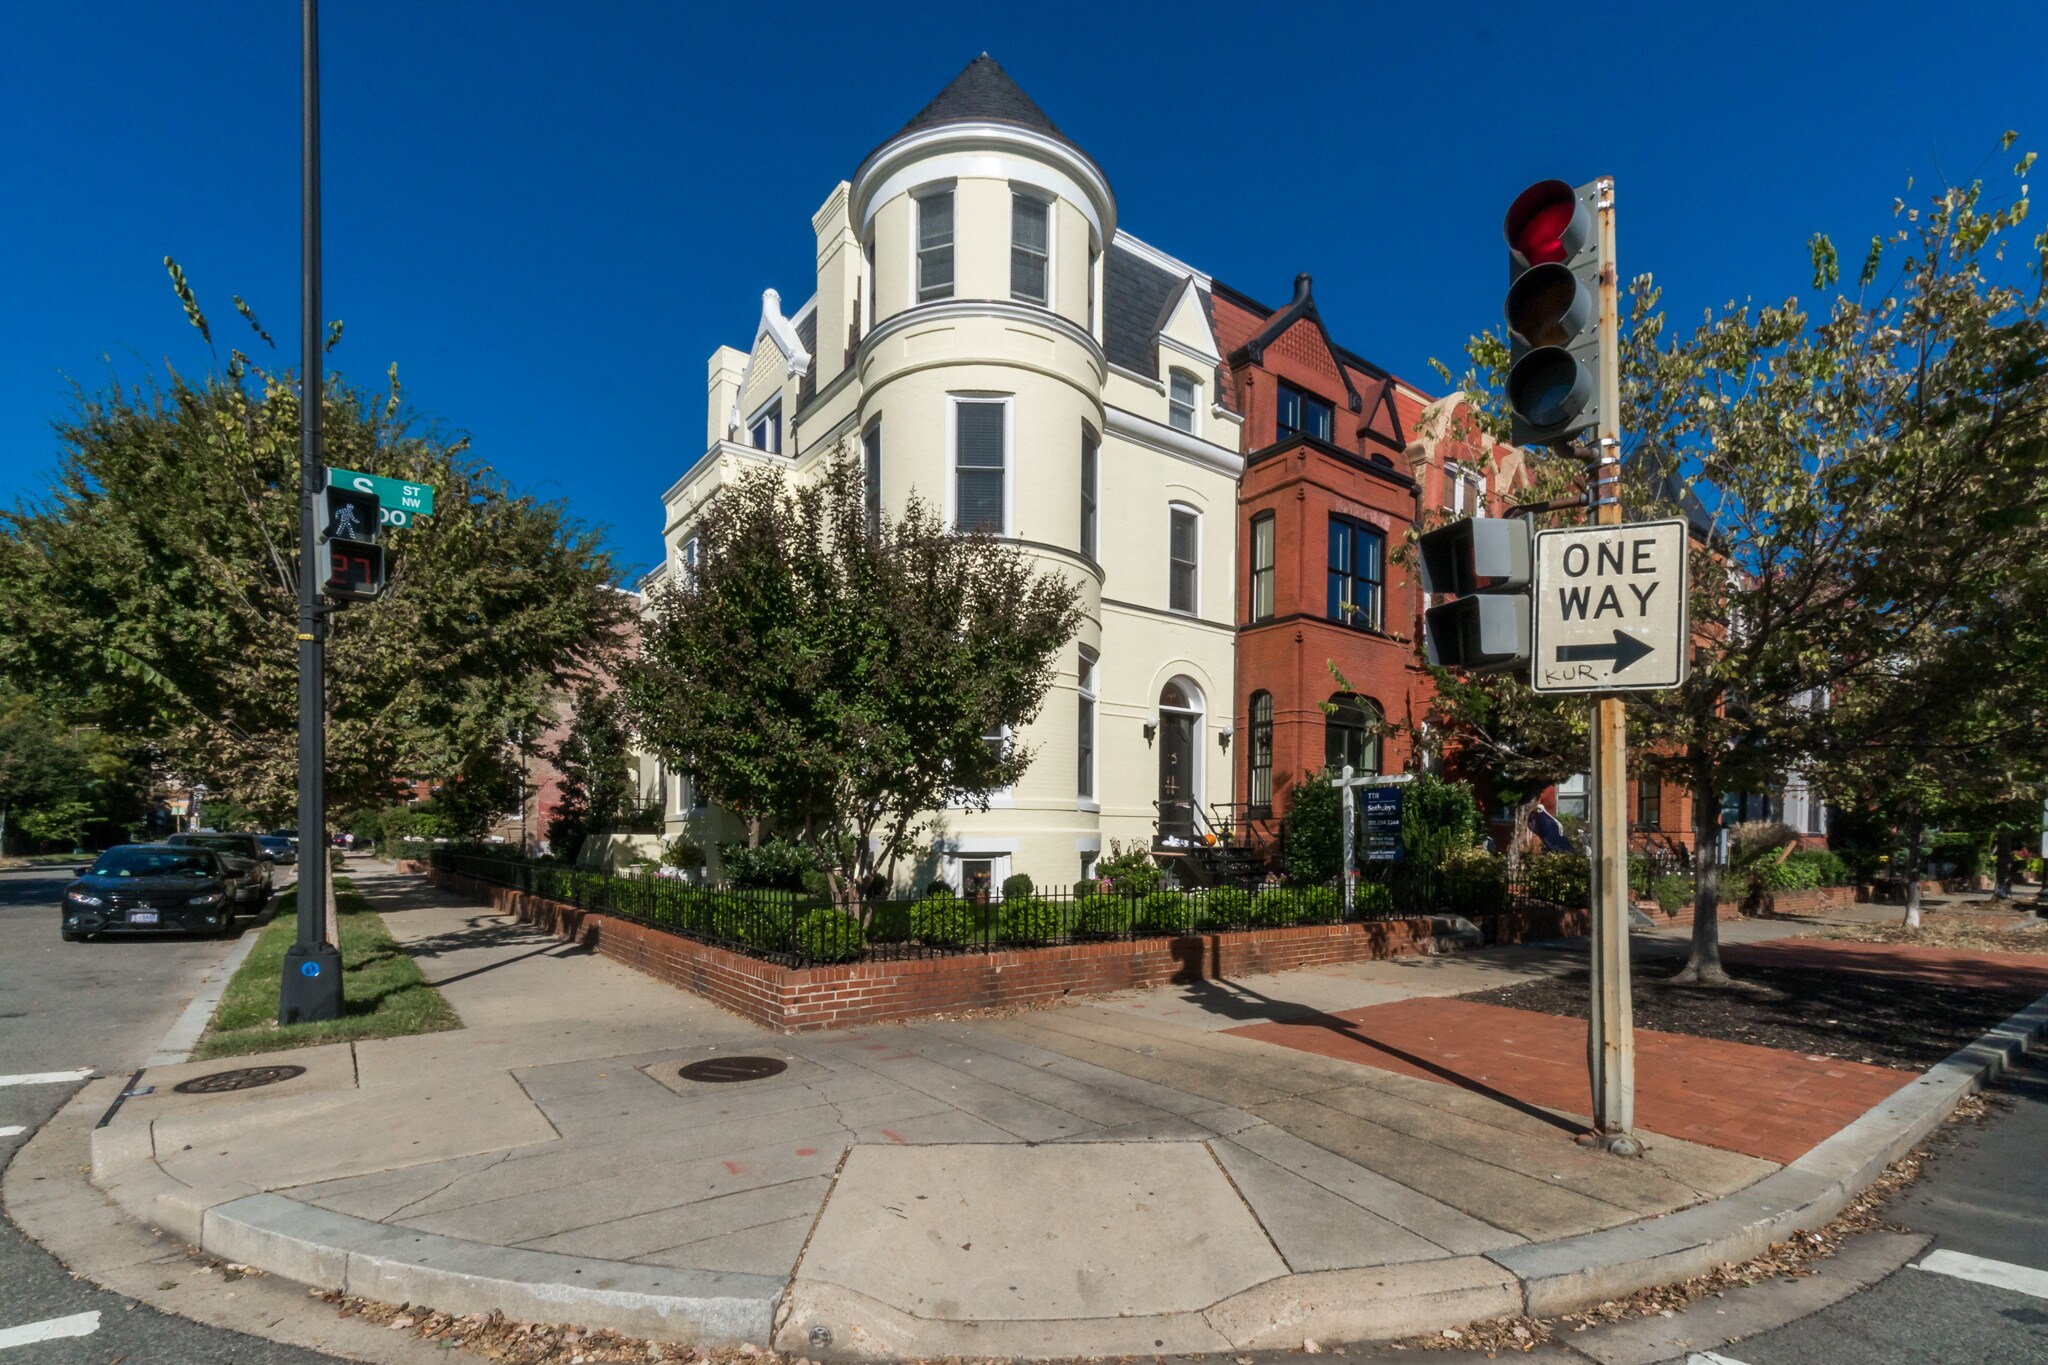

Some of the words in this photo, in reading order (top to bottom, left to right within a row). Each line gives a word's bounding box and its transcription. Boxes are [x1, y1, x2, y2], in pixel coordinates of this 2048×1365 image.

[402, 497, 420, 508] NW
[403, 485, 420, 497] ST
[1563, 539, 1656, 577] ONE
[1559, 581, 1660, 621] WAY
